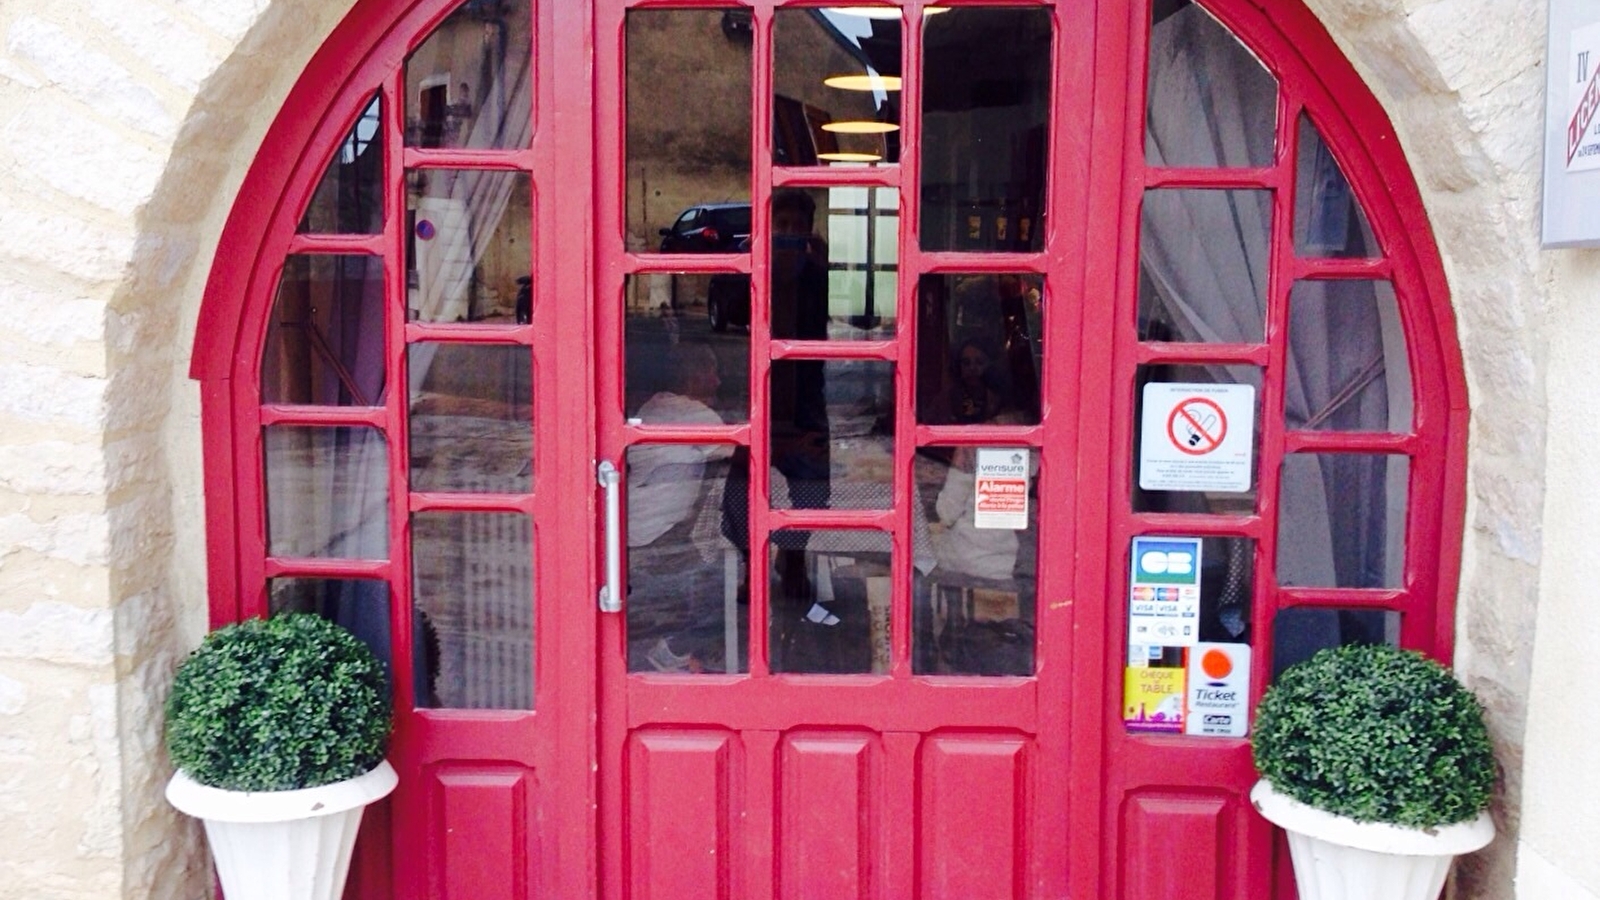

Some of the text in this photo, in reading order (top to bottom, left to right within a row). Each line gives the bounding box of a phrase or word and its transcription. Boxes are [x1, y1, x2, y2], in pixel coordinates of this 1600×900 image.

[1577, 51, 1589, 83] IV
[979, 481, 1025, 493] Alarme
[1140, 684, 1173, 693] TABLE
[1195, 688, 1236, 701] Ticket
